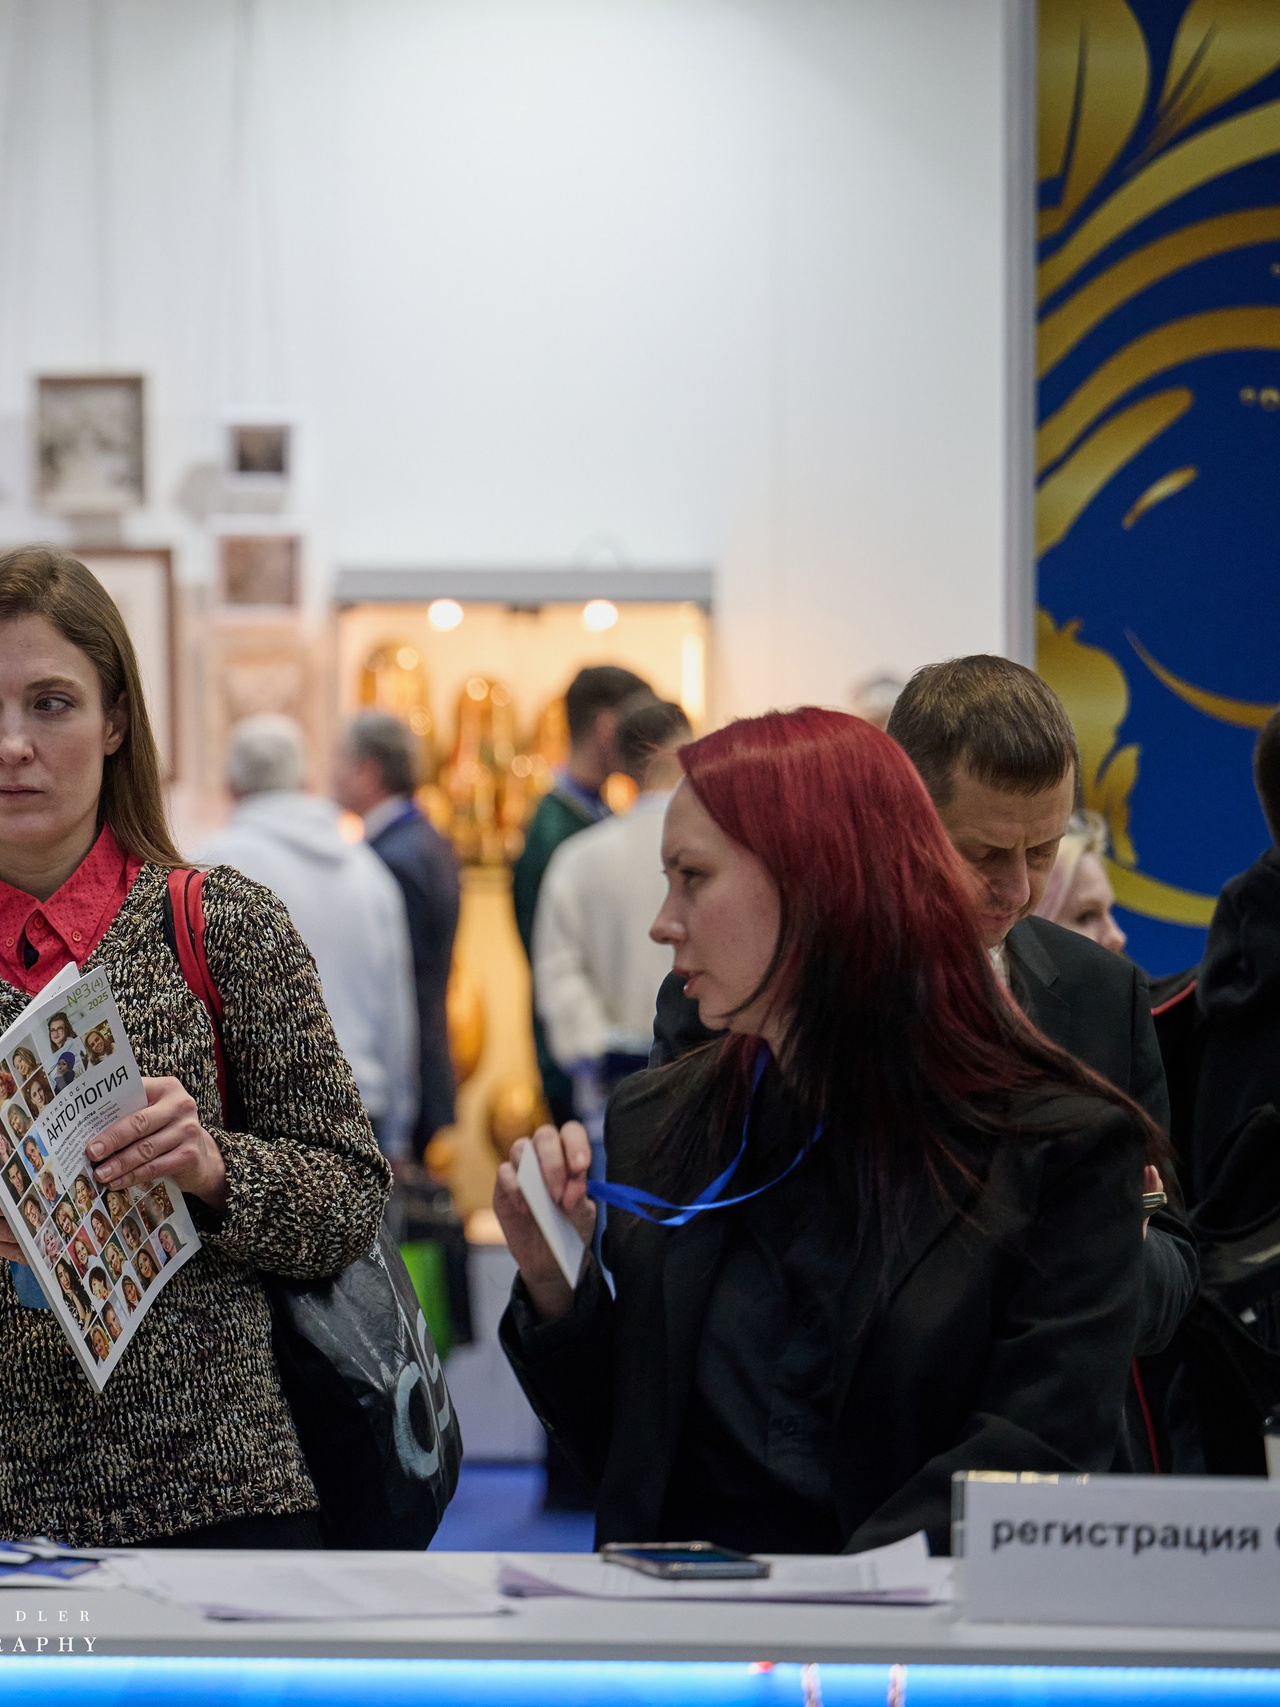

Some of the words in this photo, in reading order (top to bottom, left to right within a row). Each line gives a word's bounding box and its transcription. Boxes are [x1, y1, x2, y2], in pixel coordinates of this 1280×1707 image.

[87, 991, 108, 1010] 2025
[42, 1082, 86, 1126] ANTHOLOGY
[46, 1065, 129, 1146] АНТОЛОГИЯ
[991, 1520, 1259, 1555] регистрация
